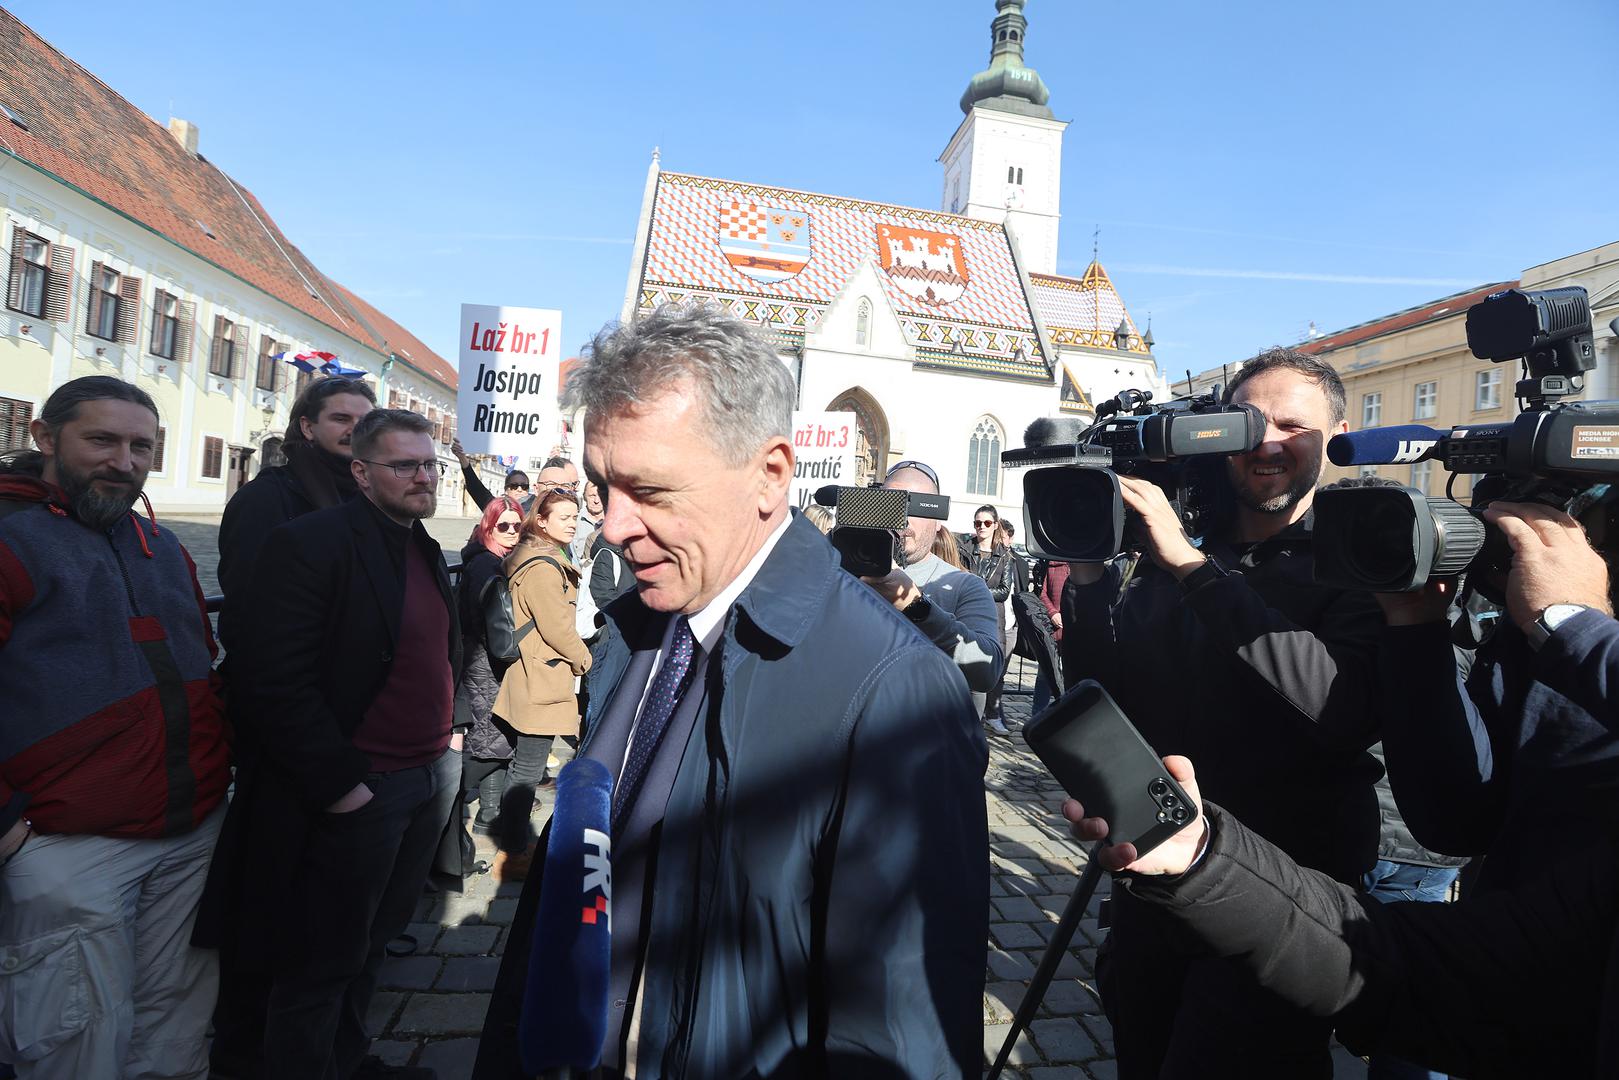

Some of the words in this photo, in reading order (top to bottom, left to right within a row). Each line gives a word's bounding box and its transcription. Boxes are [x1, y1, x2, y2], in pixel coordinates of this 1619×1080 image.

[470, 322, 508, 352] Laž
[510, 324, 550, 355] br.1
[473, 363, 542, 400] Josipa
[473, 404, 540, 435] Rimac
[1475, 428, 1501, 436] SONY
[794, 424, 814, 447] až
[816, 424, 849, 448] br.3
